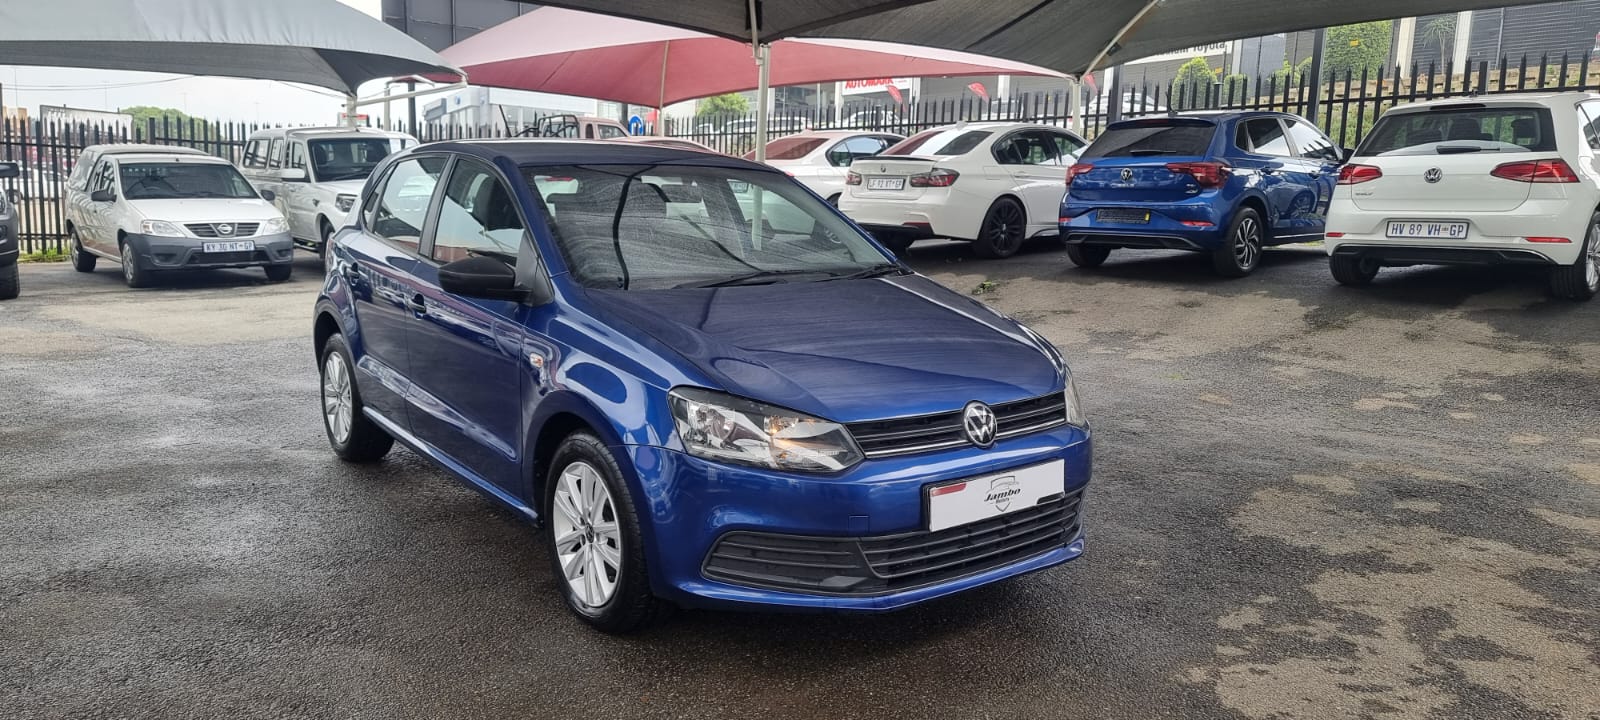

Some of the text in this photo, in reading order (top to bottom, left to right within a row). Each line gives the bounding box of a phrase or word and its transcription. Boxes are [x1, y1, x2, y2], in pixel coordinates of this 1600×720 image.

[1391, 223, 1464, 236] HV 89 VH GP
[243, 242, 252, 250] GP
[983, 489, 1021, 502] Jambo
